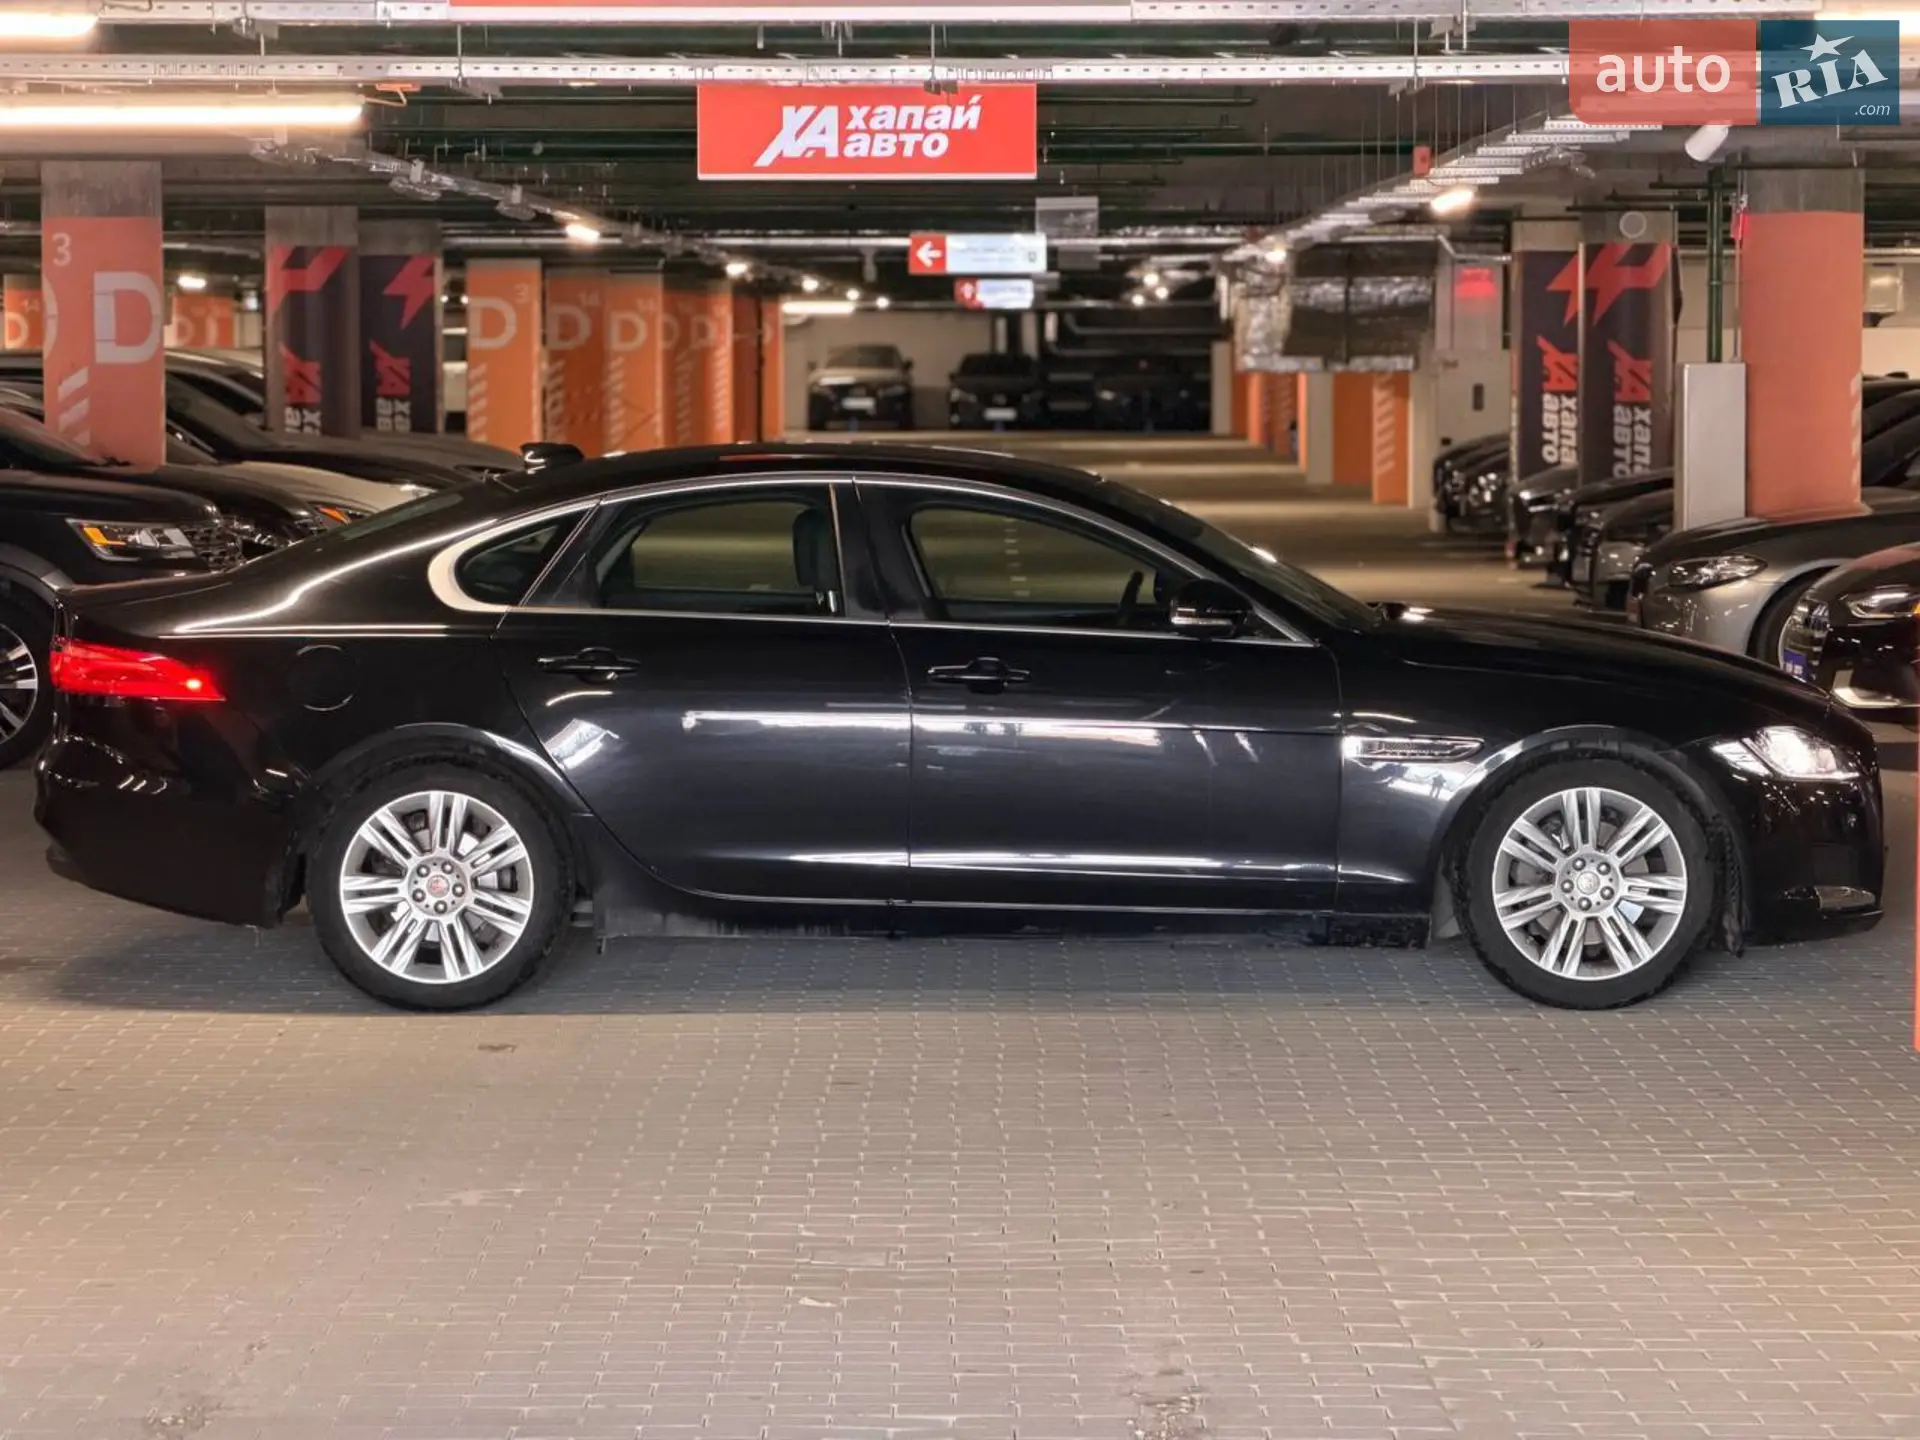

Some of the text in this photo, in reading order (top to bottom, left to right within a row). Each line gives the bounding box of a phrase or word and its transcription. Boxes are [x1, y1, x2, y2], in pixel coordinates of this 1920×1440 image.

[846, 94, 983, 131] хапай
[843, 132, 950, 158] авто
[51, 232, 72, 267] 3
[94, 271, 164, 364] D
[468, 296, 517, 349] D
[547, 304, 592, 350] D
[610, 311, 649, 351] D
[1542, 393, 1560, 464] авто
[1560, 393, 1578, 465] хапа
